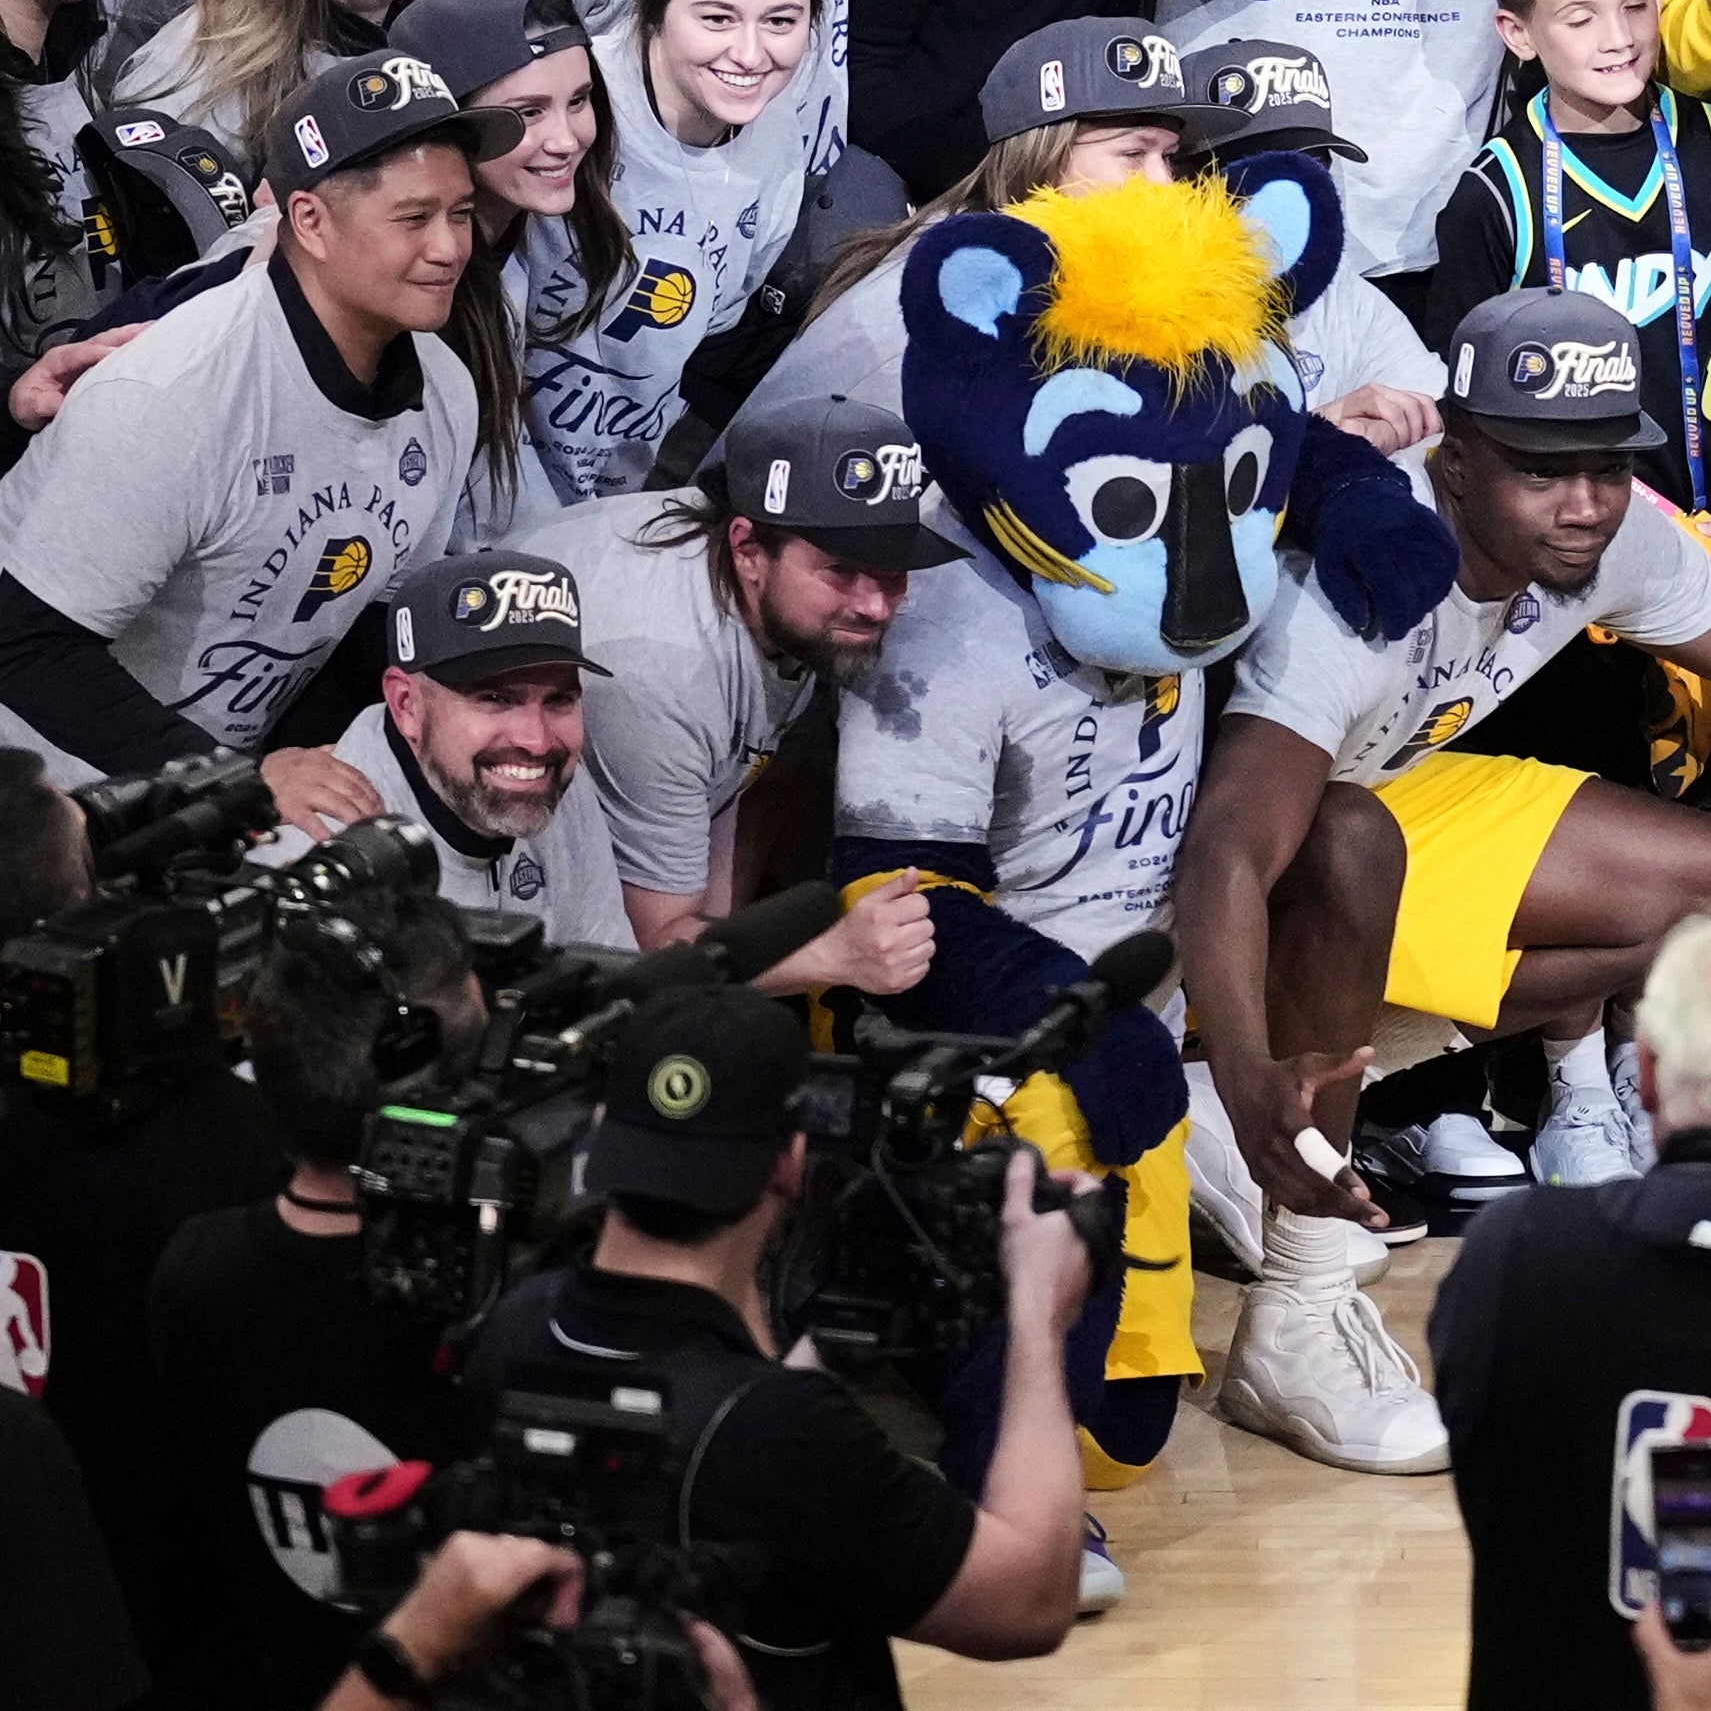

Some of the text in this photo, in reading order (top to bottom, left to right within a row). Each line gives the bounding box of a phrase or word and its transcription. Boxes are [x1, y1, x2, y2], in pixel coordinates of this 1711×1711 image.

[1295, 12, 1460, 23] EASTERN CONFERENCE
[1336, 28, 1420, 38] CHAMPIONS
[1268, 92, 1293, 107] 2025
[1546, 141, 1560, 213] REVVED UP
[1536, 341, 1635, 398] Finals
[1565, 384, 1590, 397] 2025
[231, 486, 354, 623] INDIANA
[508, 609, 536, 623] 2025
